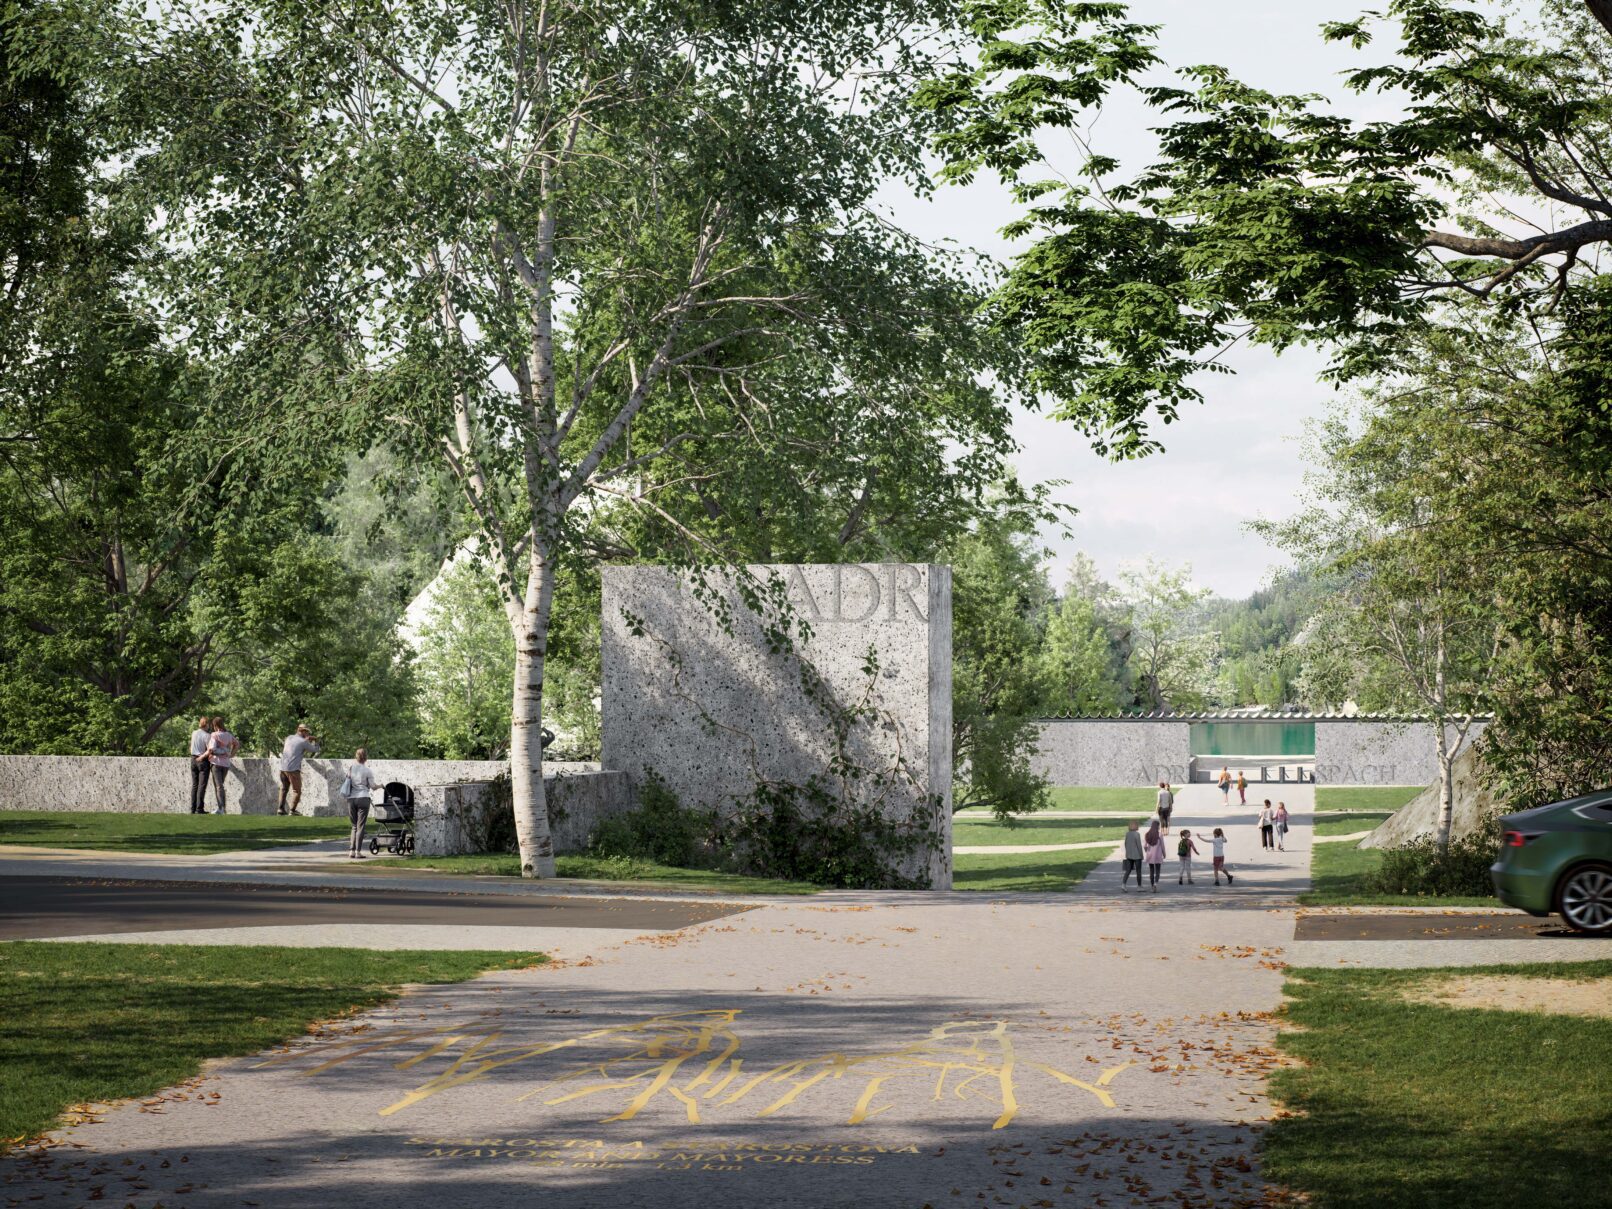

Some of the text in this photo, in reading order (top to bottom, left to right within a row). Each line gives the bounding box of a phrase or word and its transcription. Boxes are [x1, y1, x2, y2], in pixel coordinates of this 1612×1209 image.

[780, 563, 929, 623] ADR
[1136, 764, 1186, 784] ADR
[403, 1137, 605, 1148] STAROSTA
[619, 1140, 644, 1149] A
[425, 1149, 876, 1164] MAYOR AND MAYORESS
[701, 1163, 744, 1171] km
